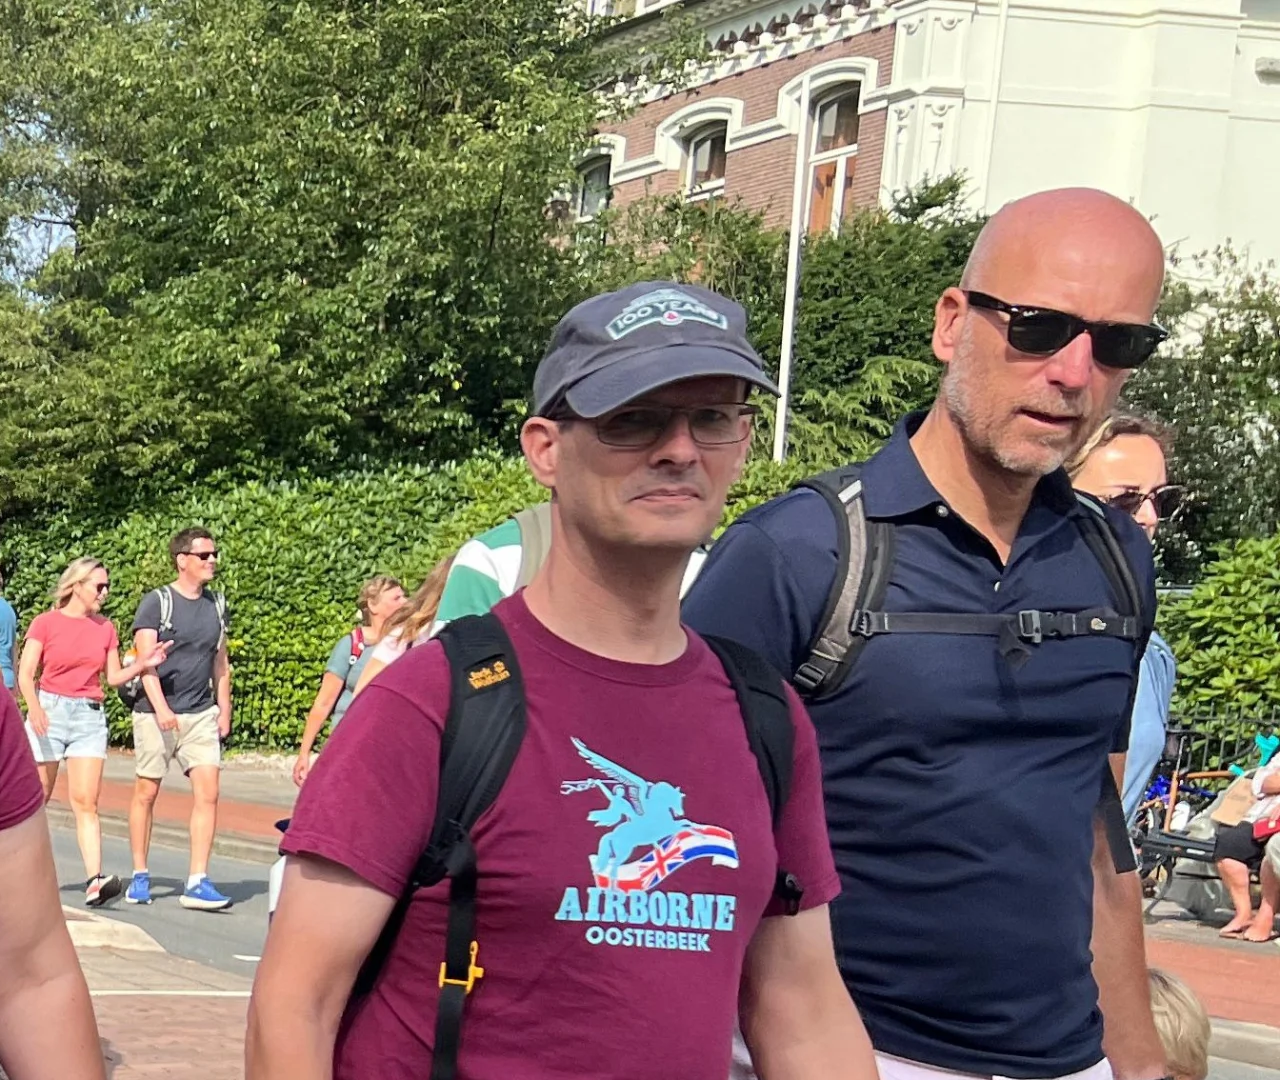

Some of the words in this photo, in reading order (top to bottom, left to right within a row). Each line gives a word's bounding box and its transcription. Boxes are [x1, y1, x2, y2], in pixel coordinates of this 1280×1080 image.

[616, 307, 652, 329] 100
[654, 301, 719, 320] YEARS
[554, 887, 736, 931] AIRBORNE
[586, 926, 711, 952] OOSTERBEEK
